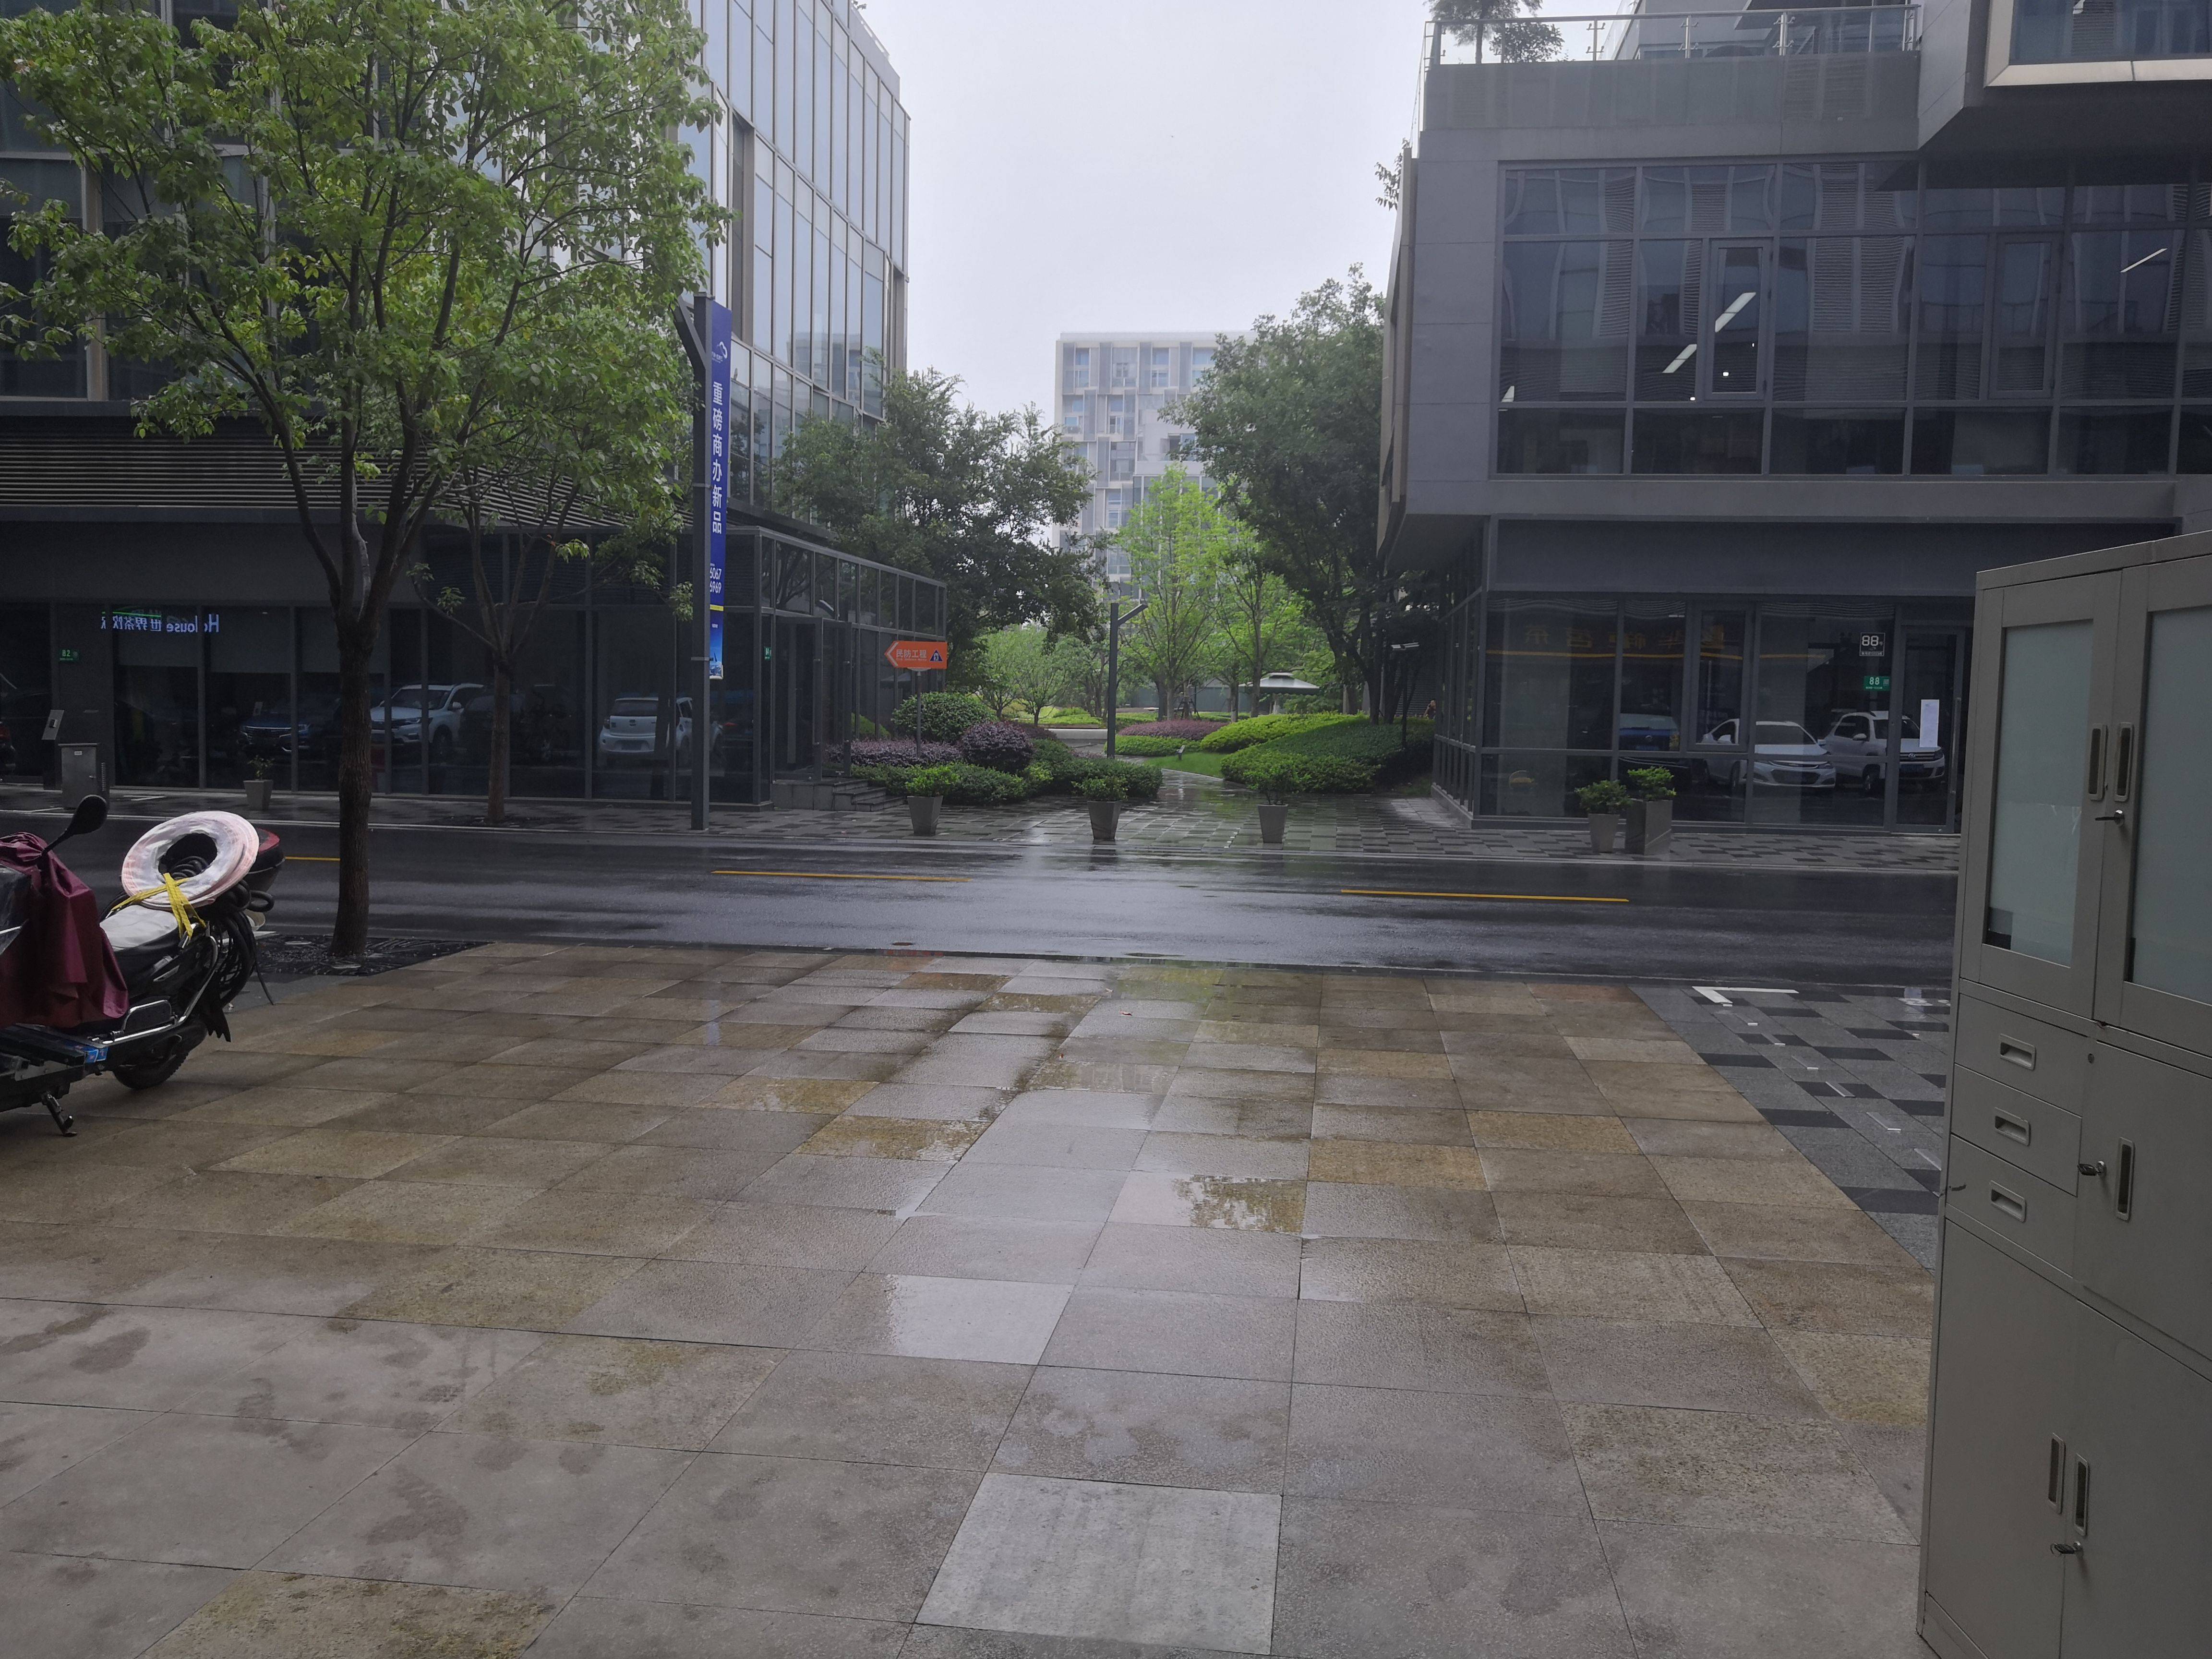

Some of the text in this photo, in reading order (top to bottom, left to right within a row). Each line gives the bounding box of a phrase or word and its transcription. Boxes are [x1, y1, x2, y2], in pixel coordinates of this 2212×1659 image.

[712, 381, 723, 535] 重磅商办新品
[896, 649, 926, 658] 民防工程
[1869, 677, 1880, 685] 88
